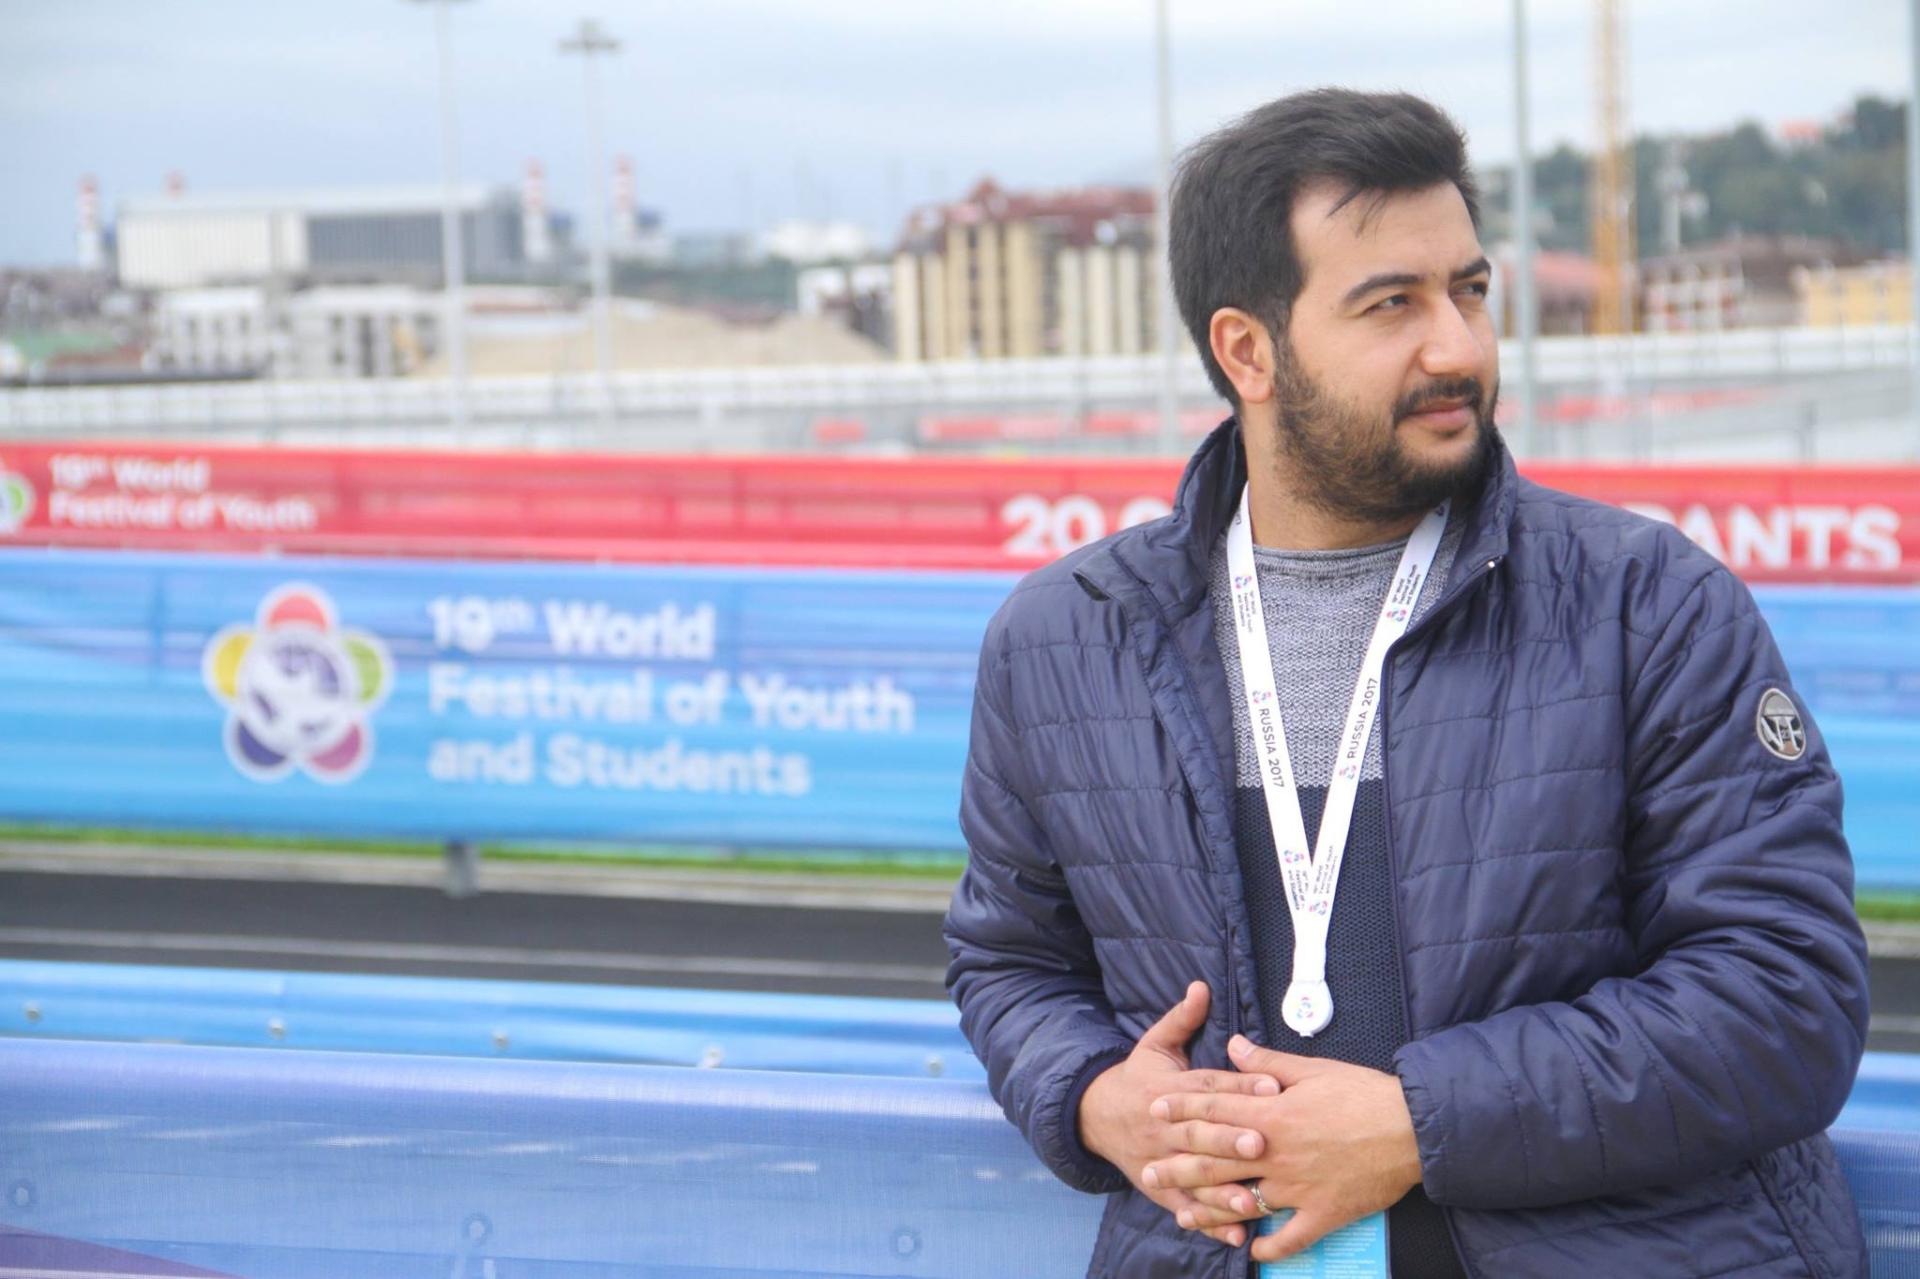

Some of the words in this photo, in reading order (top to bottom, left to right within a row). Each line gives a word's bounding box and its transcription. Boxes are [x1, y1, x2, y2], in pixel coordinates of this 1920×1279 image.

[112, 456, 211, 493] World
[49, 491, 174, 528] Festival
[176, 493, 216, 530] of
[217, 494, 317, 531] Youth
[1621, 504, 1902, 570] ANTS
[427, 597, 535, 652] 19th
[546, 599, 714, 662] World
[428, 662, 654, 724] Festival
[666, 672, 741, 727] of
[740, 675, 916, 734] Youth
[1347, 711, 1368, 759] RUSSIA
[1362, 678, 1378, 706] 2017
[428, 732, 534, 784] and
[547, 732, 812, 797] Students
[1259, 708, 1276, 755] RUSSIA
[1268, 759, 1285, 788] 2017
